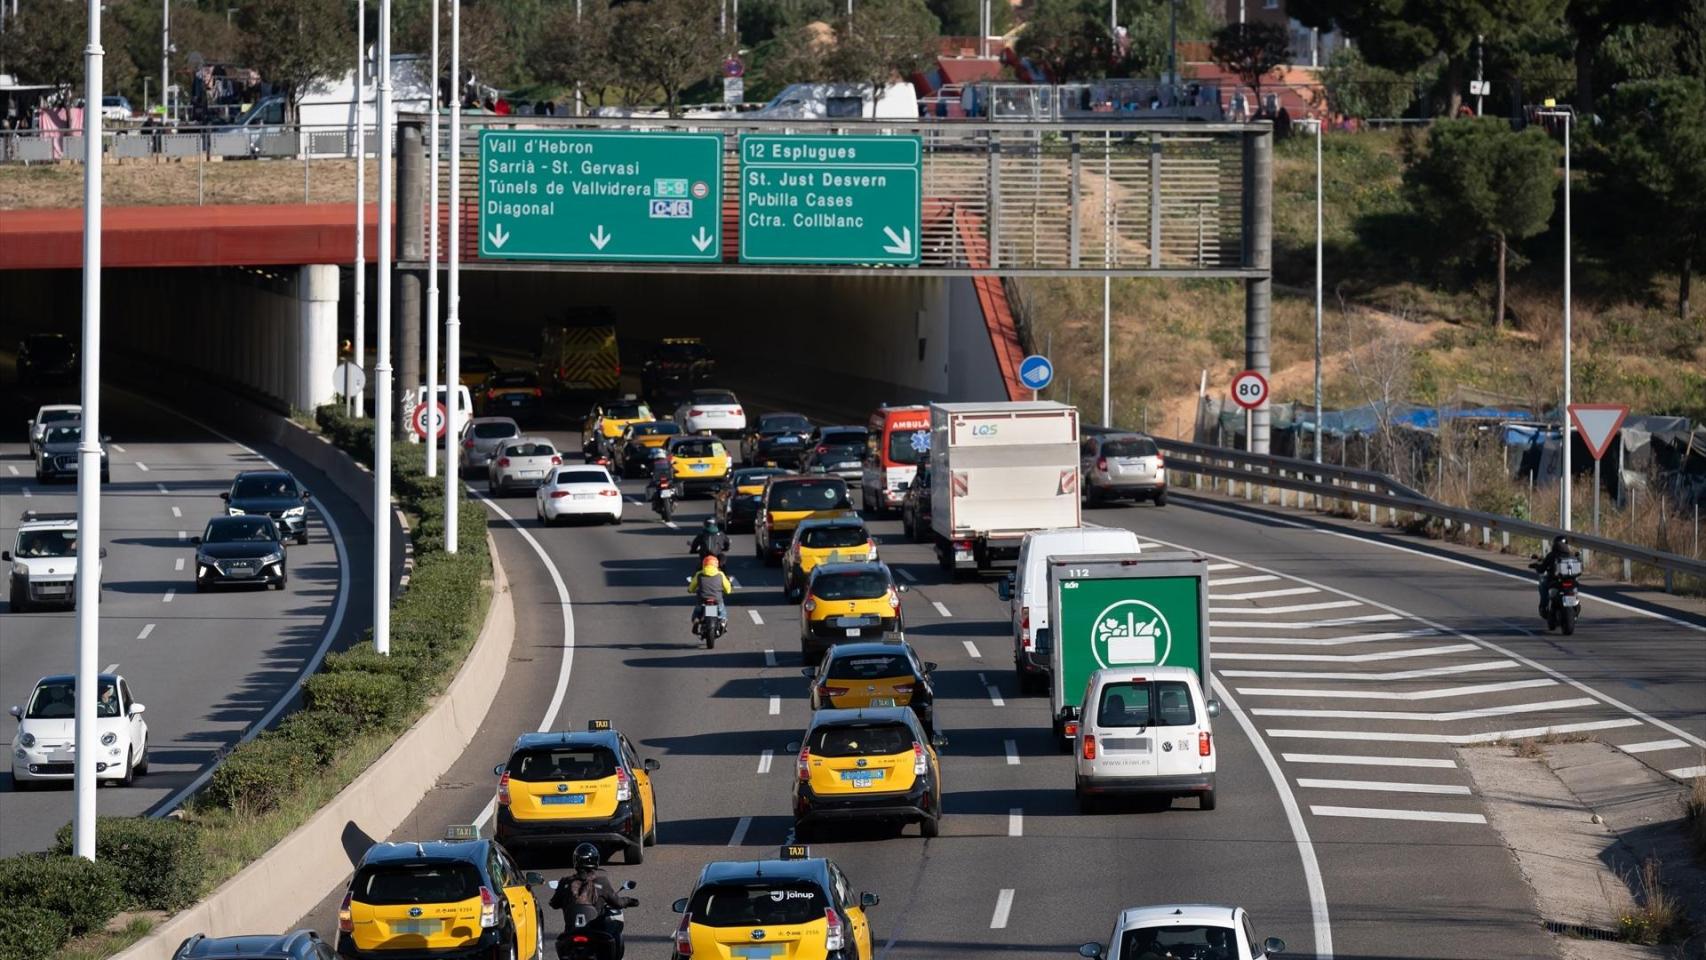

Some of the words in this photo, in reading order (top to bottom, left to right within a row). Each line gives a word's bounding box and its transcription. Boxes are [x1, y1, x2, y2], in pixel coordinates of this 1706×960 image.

[489, 139, 516, 153] Vall
[524, 140, 593, 154] d'Hebron
[749, 144, 765, 158] 12
[772, 144, 856, 162] Esplugues
[488, 159, 535, 174] Sarrià
[552, 160, 573, 174] St.
[581, 160, 639, 176] Gervasi
[749, 172, 771, 186] St.
[779, 172, 814, 186] Just
[822, 173, 886, 187] Desvern
[489, 180, 538, 194] Túnels
[546, 181, 564, 195] de
[572, 182, 651, 196] Vallvidrera
[657, 181, 684, 194] E-9
[748, 192, 798, 207] Pubilla
[805, 192, 853, 207] Cases
[488, 200, 554, 218] Diagonal
[748, 212, 786, 227] Ctra.
[793, 213, 863, 228] Collblanc
[1239, 383, 1261, 396] 80
[1069, 568, 1090, 577] 112
[595, 720, 608, 728] TAXI
[456, 827, 472, 836] TAXI
[788, 847, 805, 856] TAXI
[786, 890, 815, 900] joinup
